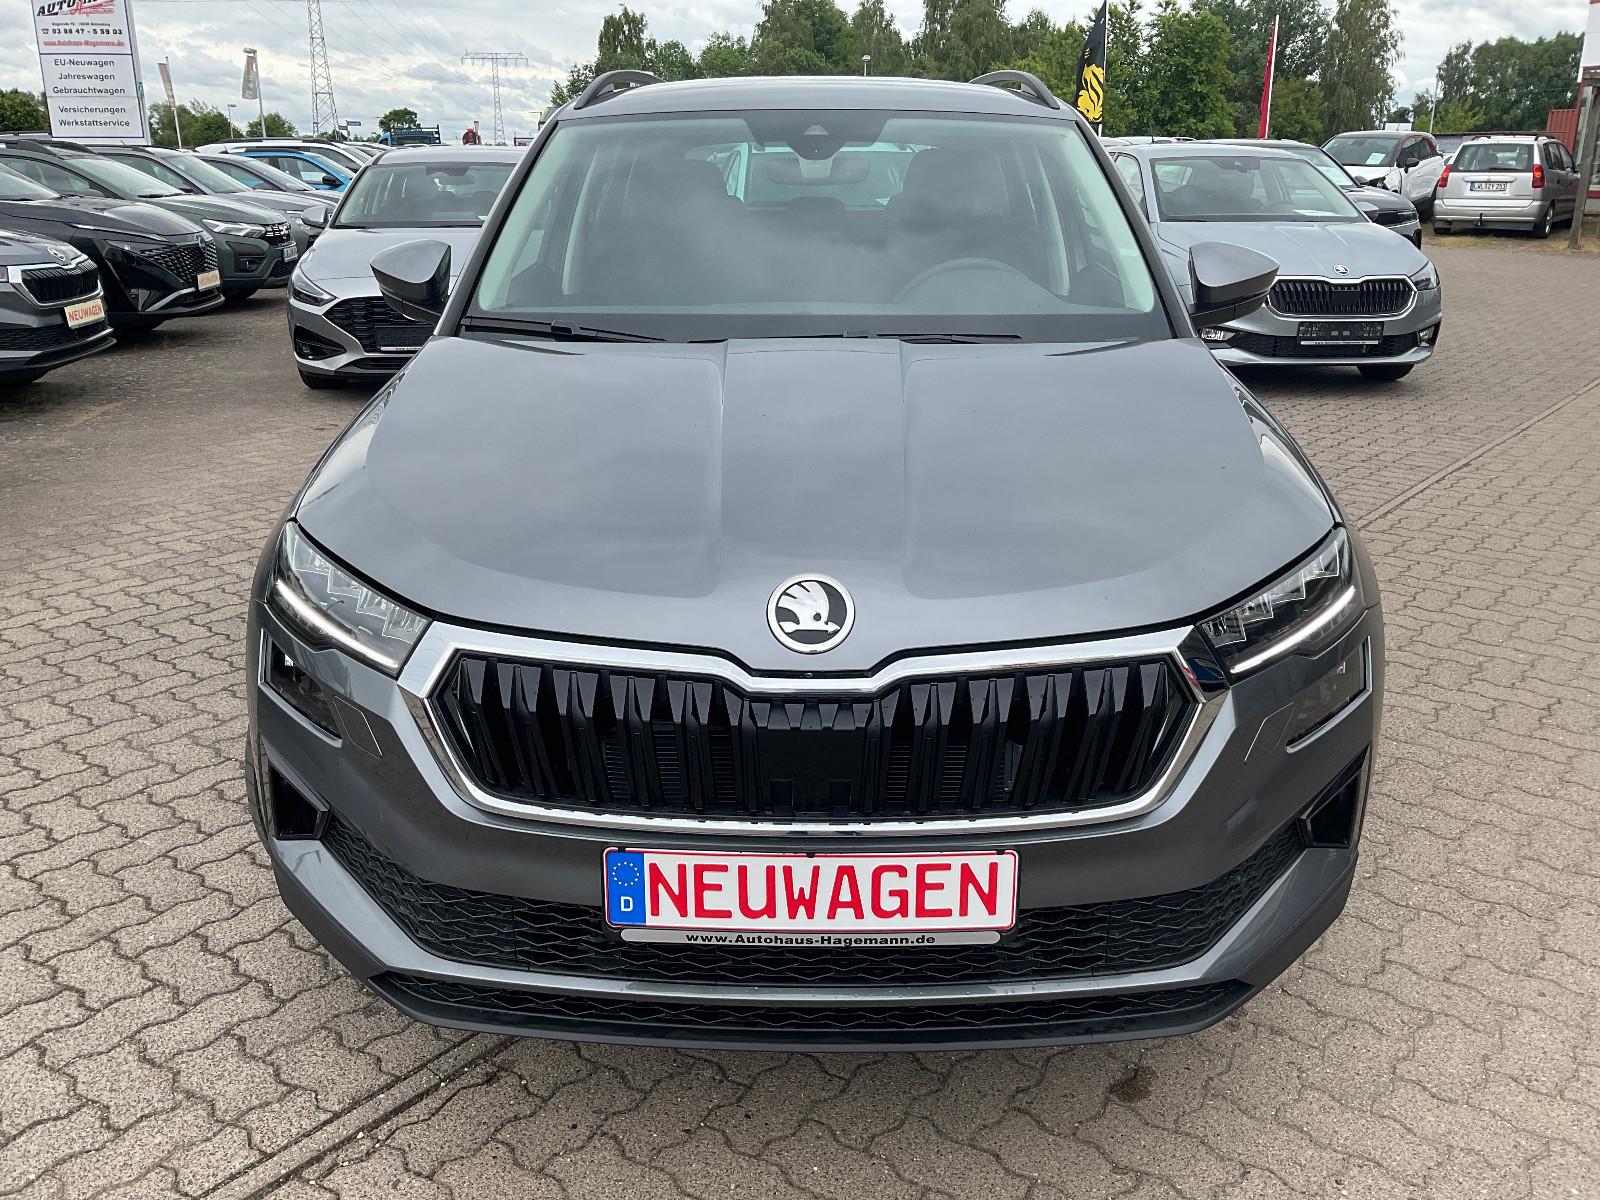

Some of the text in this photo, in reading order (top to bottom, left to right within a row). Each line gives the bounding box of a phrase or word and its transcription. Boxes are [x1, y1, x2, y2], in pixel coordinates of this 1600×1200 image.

[54, 59, 115, 67] EU-Neuwagen
[58, 73, 115, 81] Jahreswagen
[52, 86, 126, 95] Gebrauchtwagen
[58, 106, 126, 114] Versicherungen
[58, 119, 130, 127] Werkstattservice
[68, 304, 103, 322] NEUWAGEN
[620, 861, 998, 920] D NEUWAGEN
[686, 932, 936, 946] www.Autohaus-Hagemann.de
